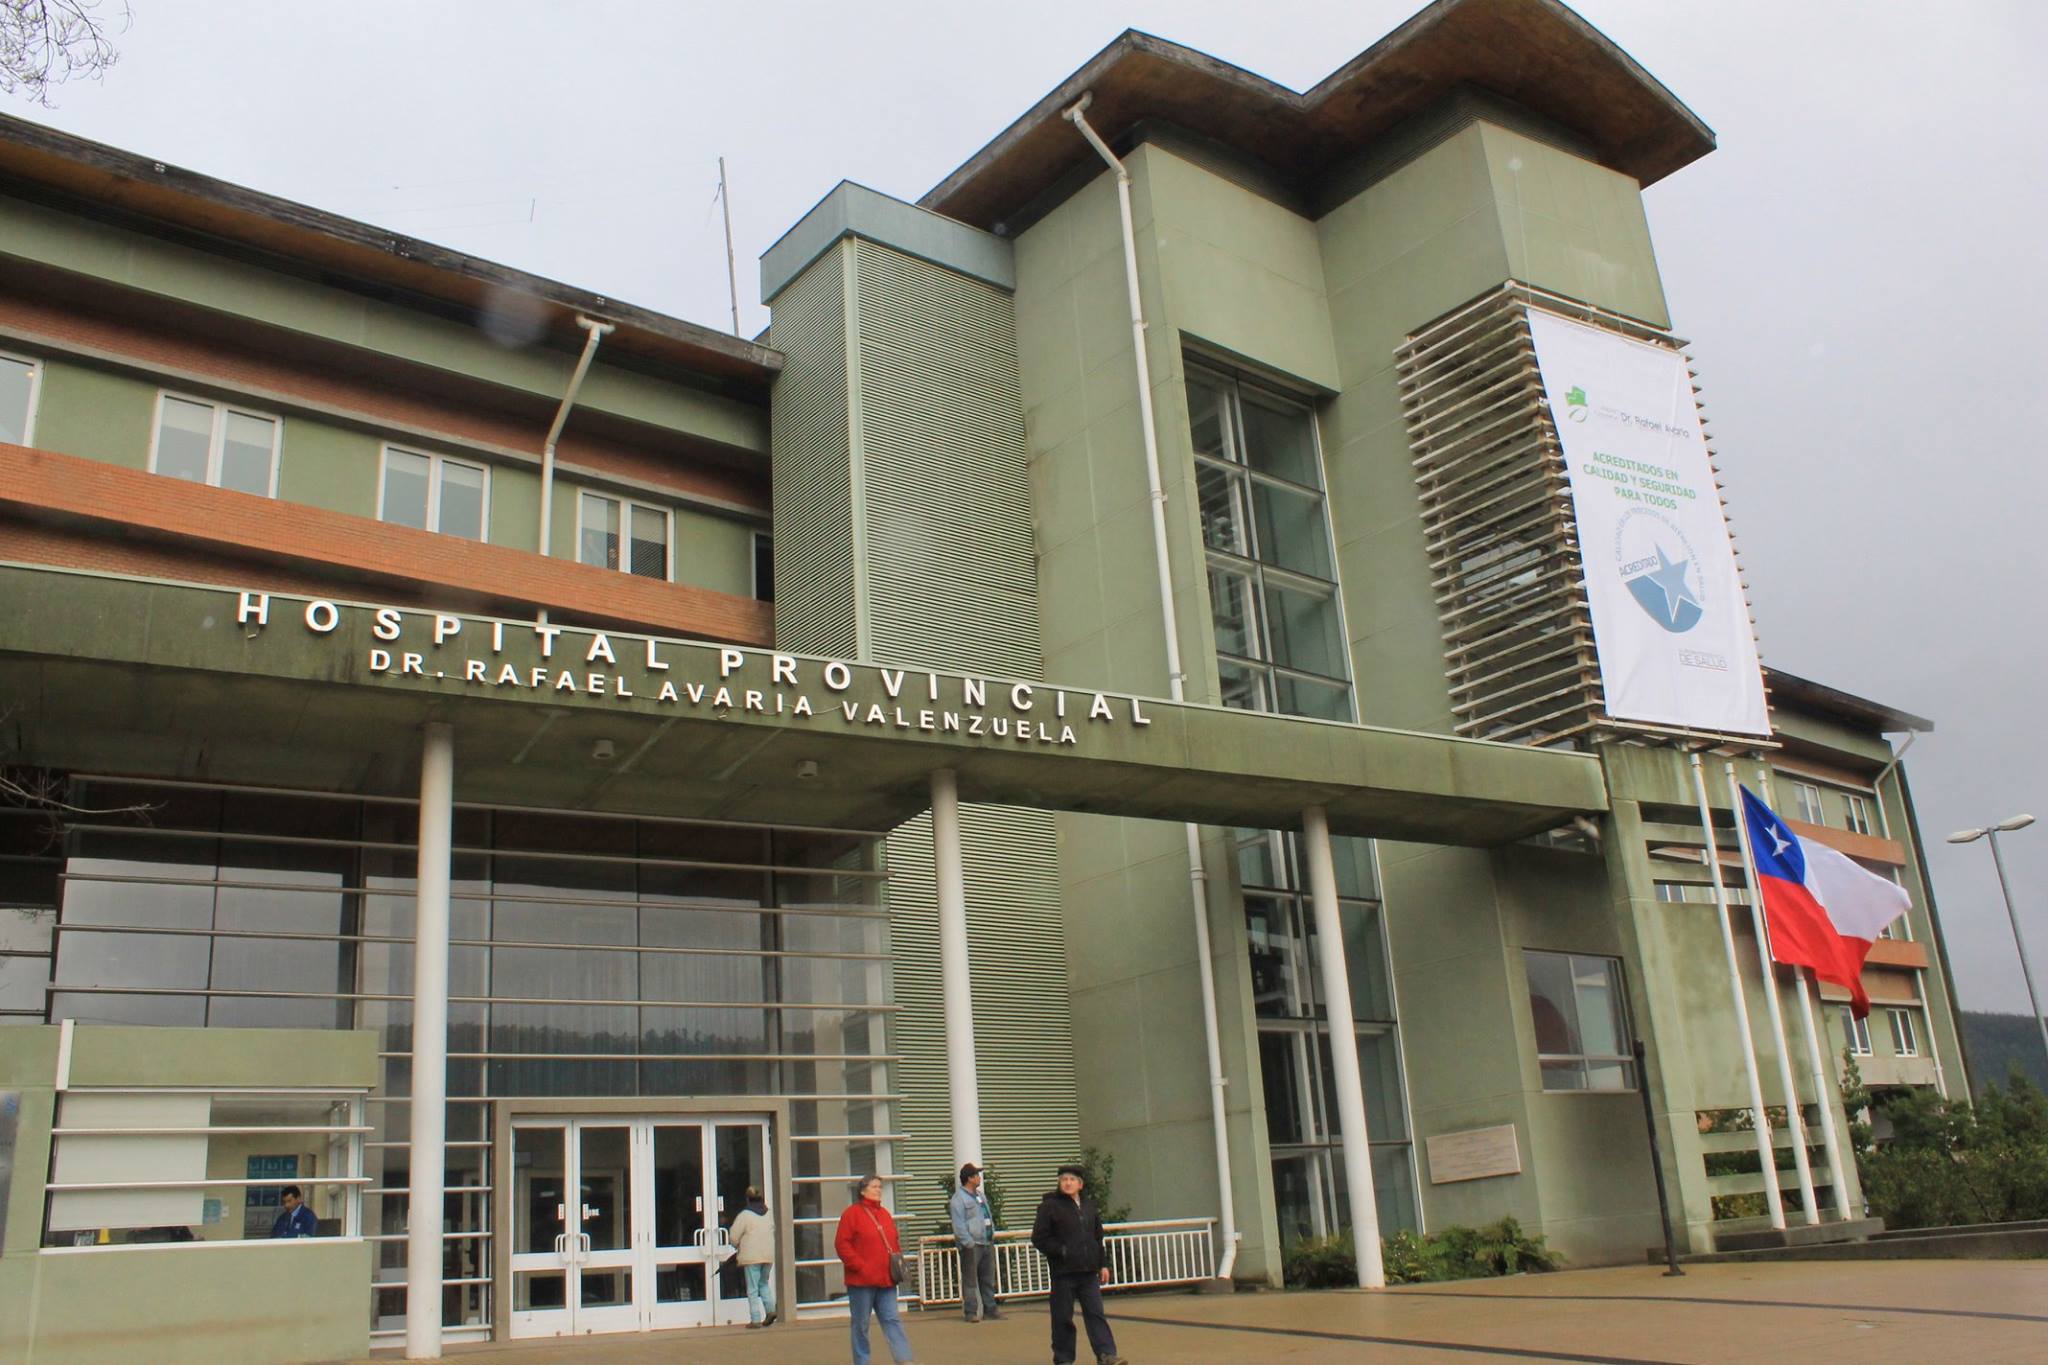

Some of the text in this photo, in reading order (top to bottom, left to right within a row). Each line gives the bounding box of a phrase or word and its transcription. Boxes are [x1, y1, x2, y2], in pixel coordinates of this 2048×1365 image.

[1635, 416, 1661, 430] Rafael
[1583, 464, 1696, 500] CALIDAD Y SEGURIDAD
[1592, 452, 1679, 481] ACREDITADOS EN
[1614, 486, 1677, 510] PARA TODOS
[237, 591, 1151, 725] HOSPITAL PROVINCIAL
[369, 648, 1077, 744] DR. RAFAEL AVARIA VALENZUELA
